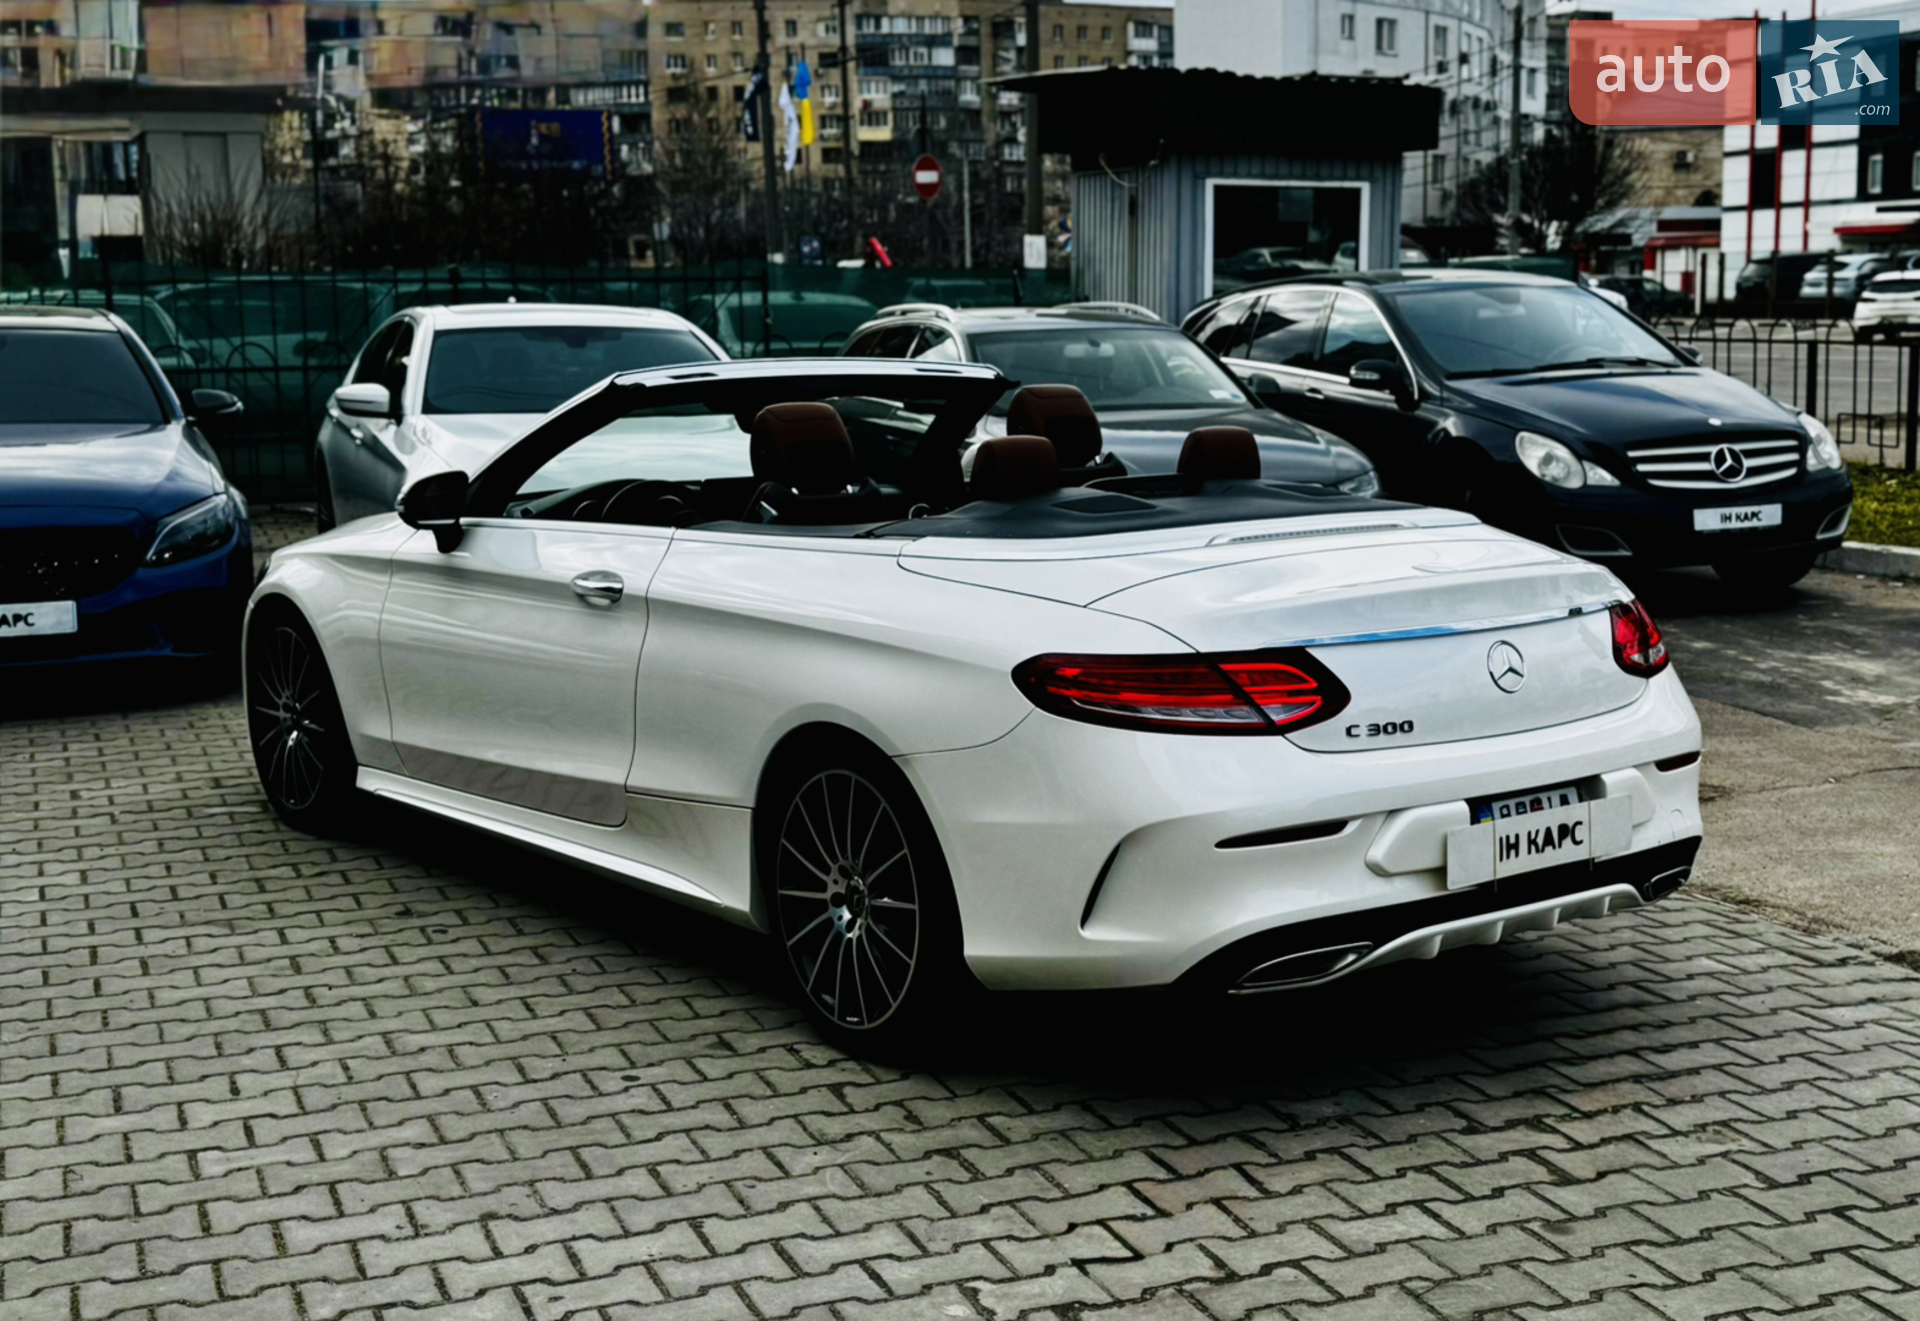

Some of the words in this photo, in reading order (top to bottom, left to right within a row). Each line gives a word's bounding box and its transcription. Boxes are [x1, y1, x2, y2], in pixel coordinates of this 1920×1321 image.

[1735, 510, 1763, 523] КАРС
[1345, 724, 1361, 738] C
[1365, 720, 1414, 737] 300
[1499, 833, 1520, 863] ІН
[1527, 820, 1584, 856] КАРС
